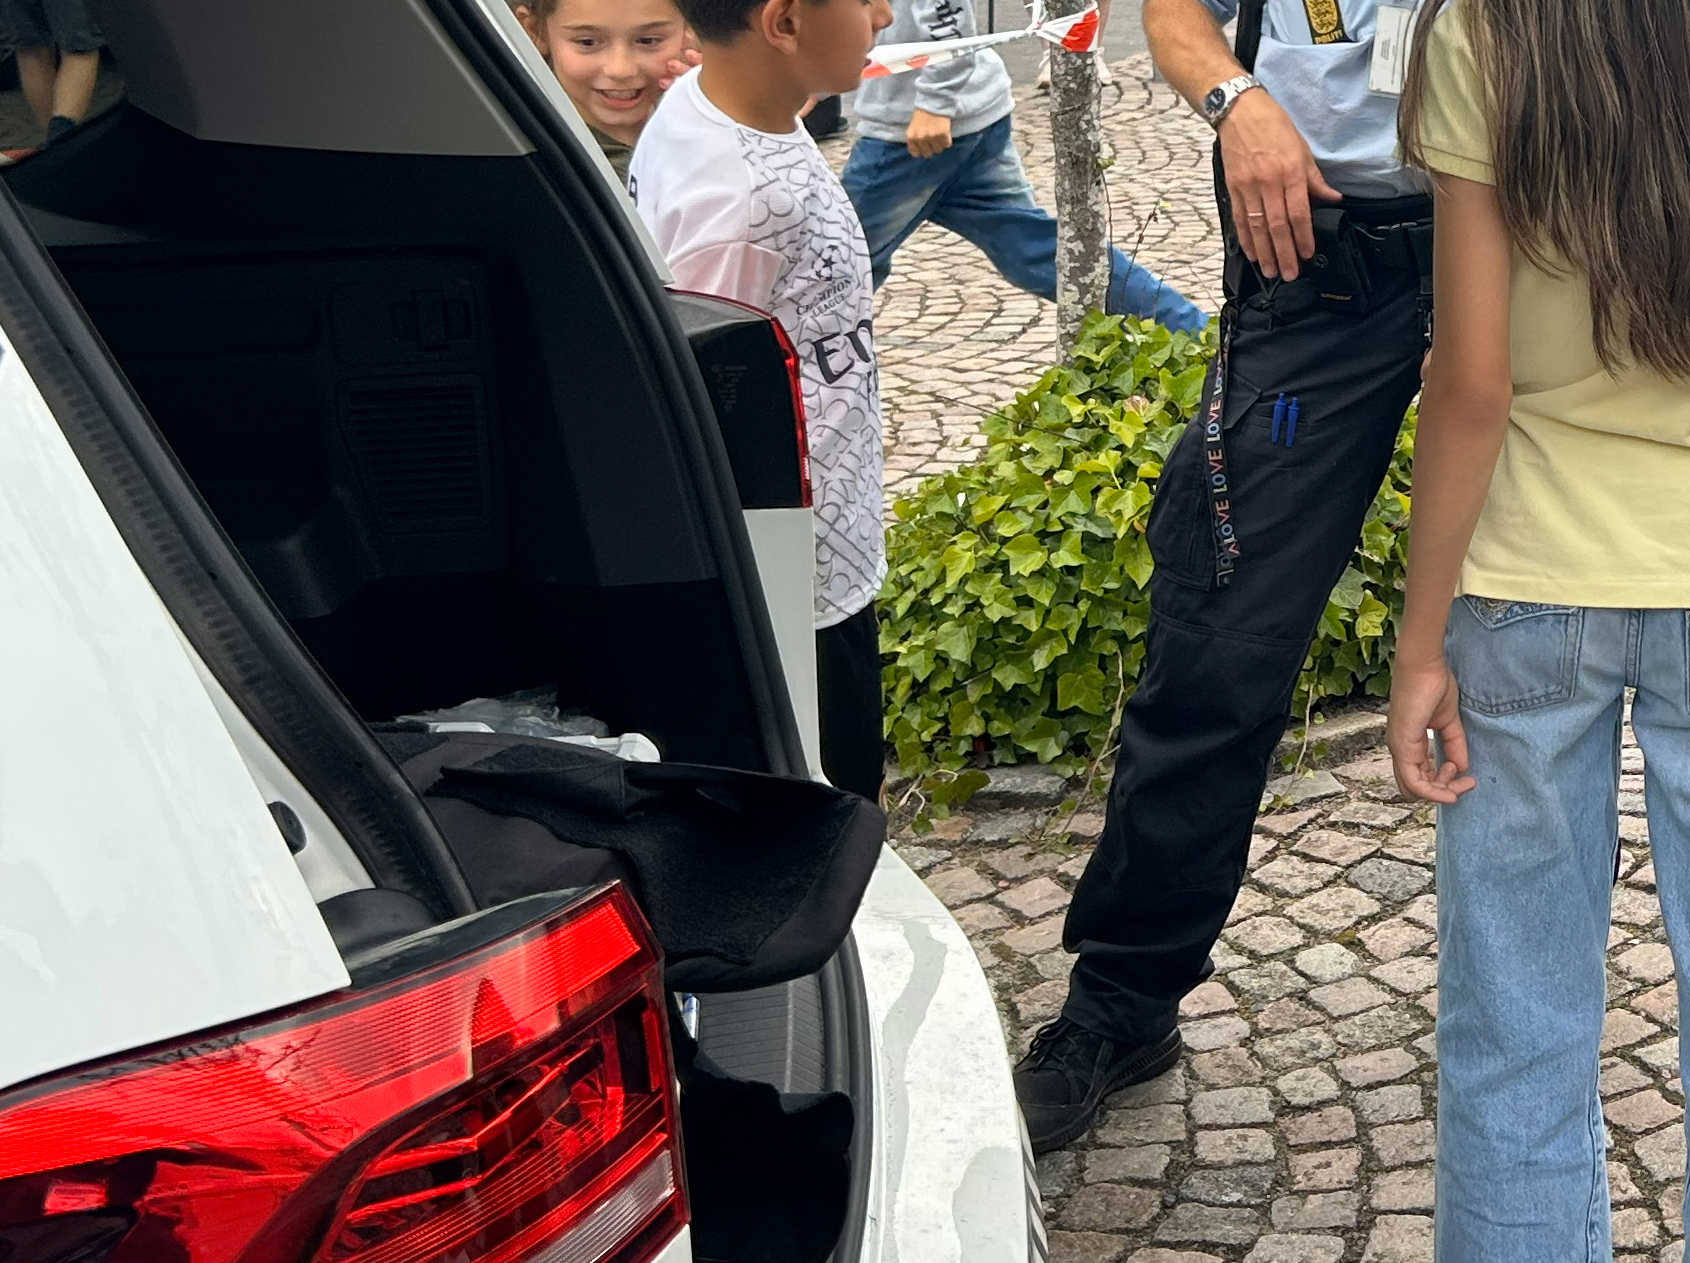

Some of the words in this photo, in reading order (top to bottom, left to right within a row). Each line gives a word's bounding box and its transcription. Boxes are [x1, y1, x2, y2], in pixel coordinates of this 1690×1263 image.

[1206, 399, 1222, 442] LOVE
[1207, 448, 1228, 493] LOVE
[1216, 499, 1235, 544] LOVE
